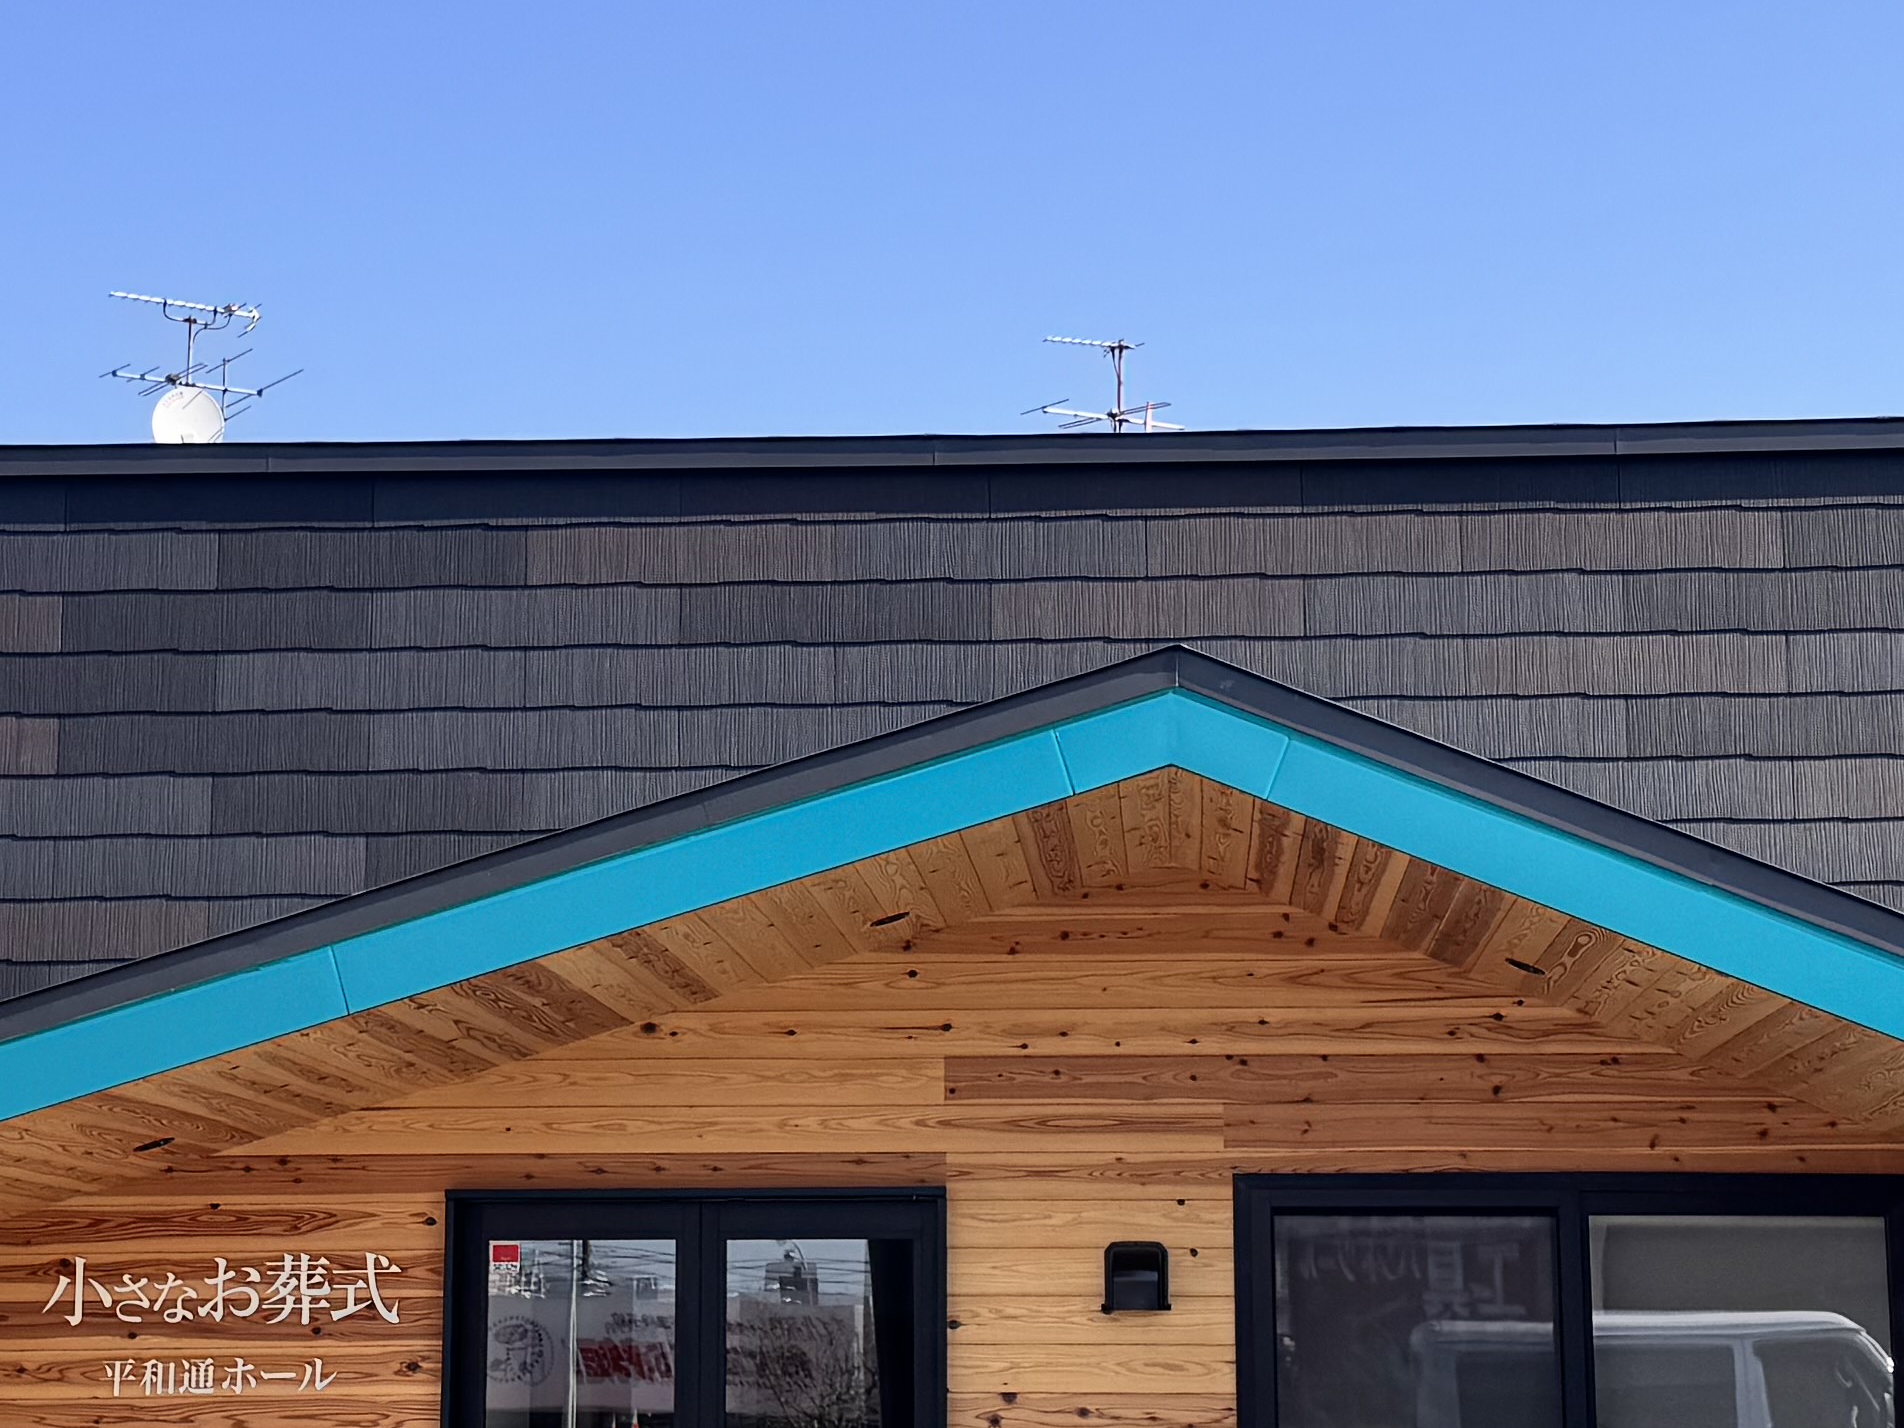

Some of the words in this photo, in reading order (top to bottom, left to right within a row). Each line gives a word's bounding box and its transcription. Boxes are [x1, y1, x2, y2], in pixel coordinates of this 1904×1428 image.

[43, 1253, 401, 1326] 小さなお葬式
[105, 1357, 336, 1397] 平和通ホール
